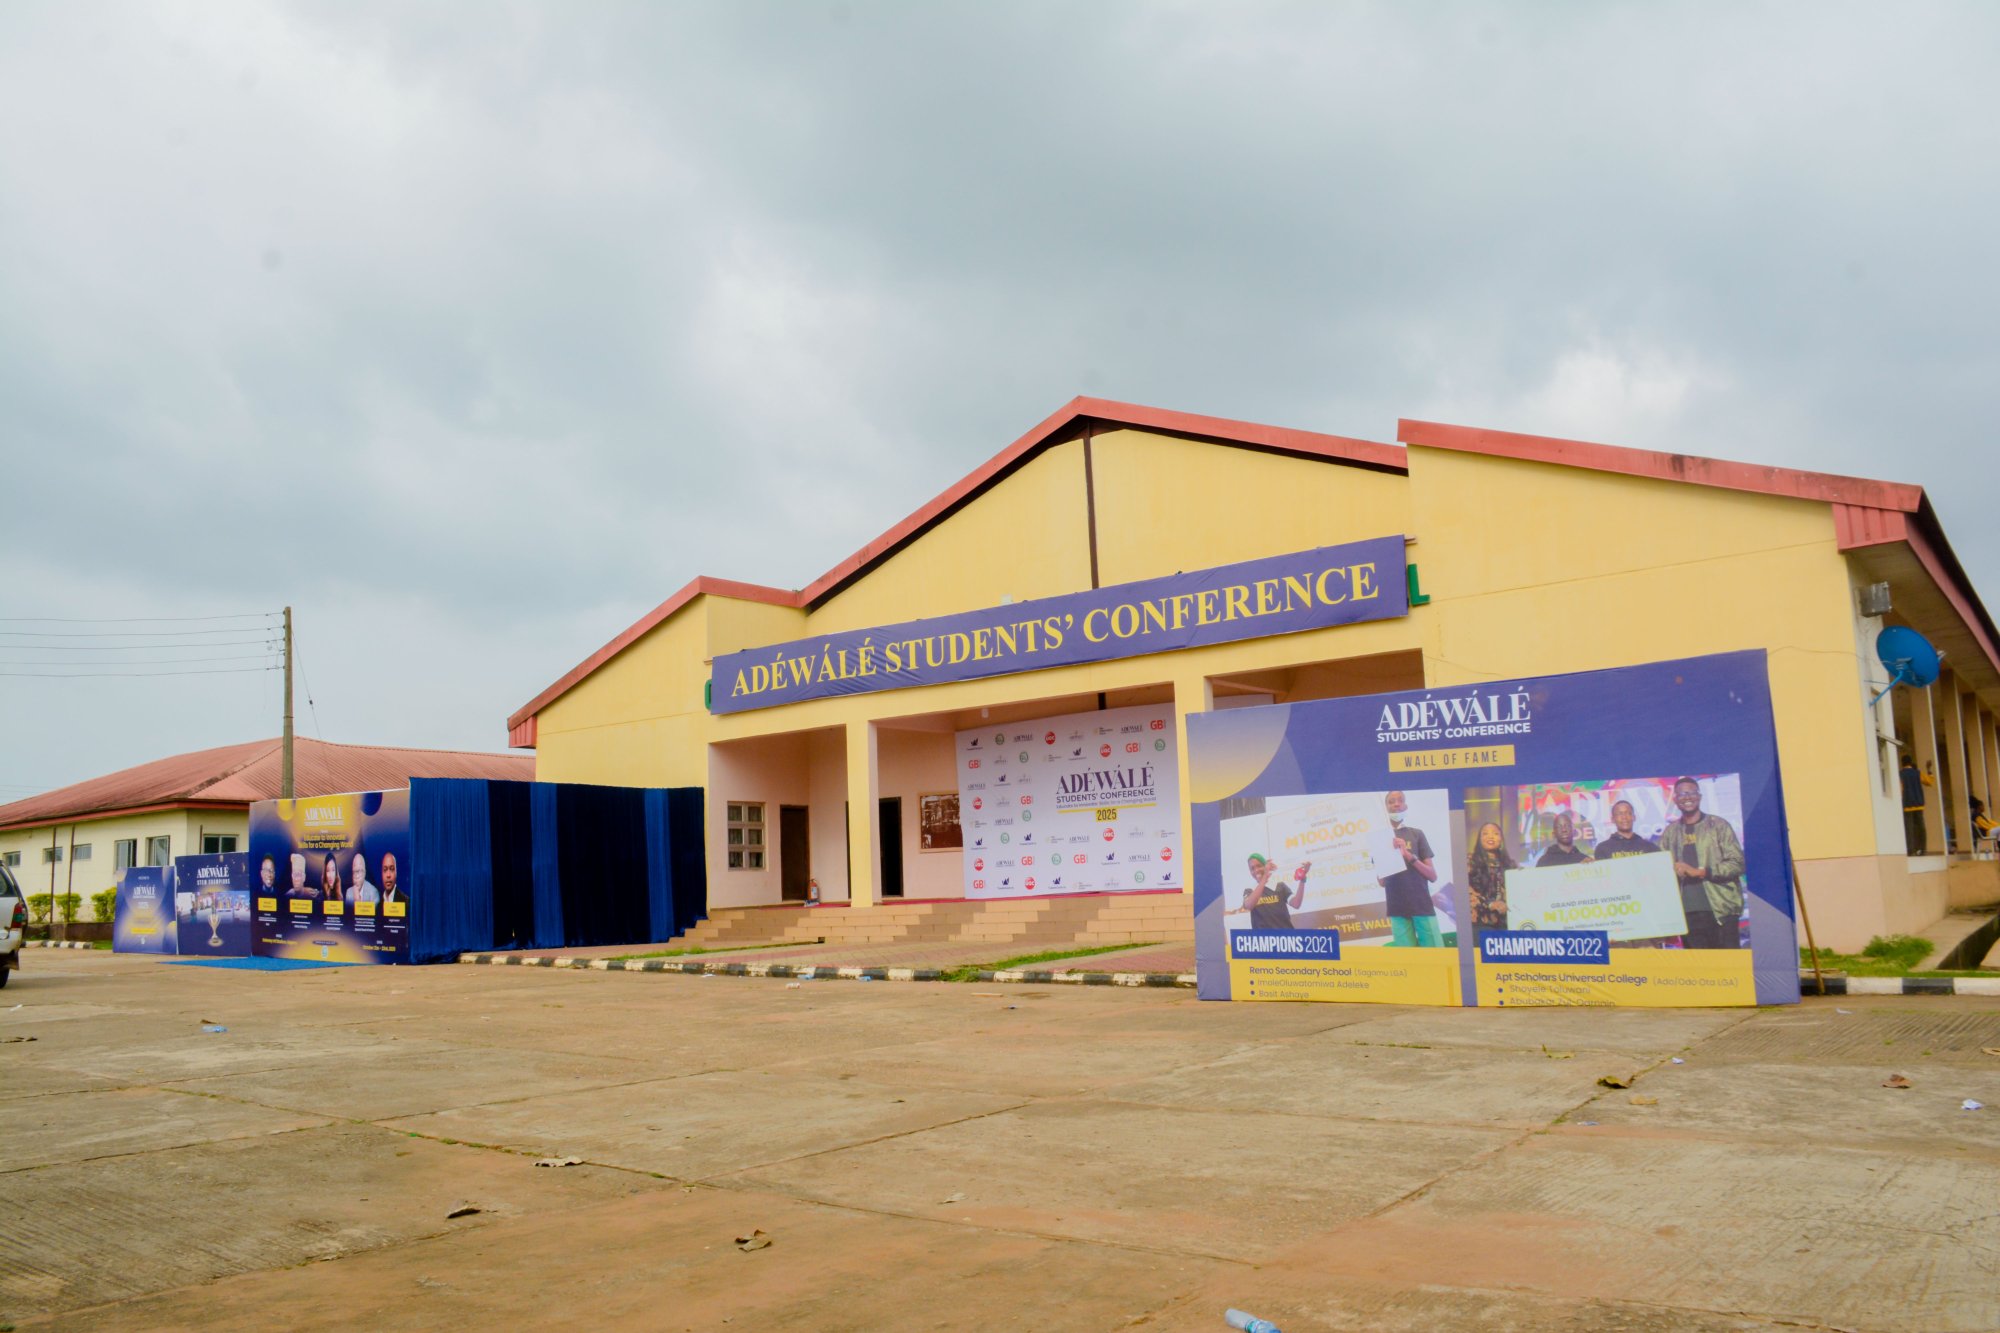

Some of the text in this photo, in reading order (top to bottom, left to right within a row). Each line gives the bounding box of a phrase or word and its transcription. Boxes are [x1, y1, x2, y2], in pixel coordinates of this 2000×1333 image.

[731, 637, 876, 697] ADÉWÁLÉ
[1083, 562, 1379, 642] CONFERENCE
[1376, 685, 1531, 731] ADÉWÁLÉ
[1445, 723, 1531, 738] CONFERENCE
[1404, 750, 1498, 767] WALL OF FAME
[1056, 761, 1155, 794] ADÉWÁLÉ
[1100, 787, 1155, 800] CONFERENCE
[1097, 809, 1117, 821] 2025
[1550, 894, 1631, 909] GRAND PRIZE WINNER
[1341, 922, 1361, 933] THE
[1236, 935, 1334, 953] CHAMPIONS 2021
[1485, 937, 1602, 957] CHAMPIONS 2022
[1249, 966, 1273, 975] Remo
[1275, 966, 1320, 977] Secondary
[1322, 967, 1352, 976] School
[1495, 972, 1513, 984] Apt
[1514, 972, 1557, 982] Scholars
[1559, 973, 1606, 983] Universal
[1607, 974, 1648, 985] College
